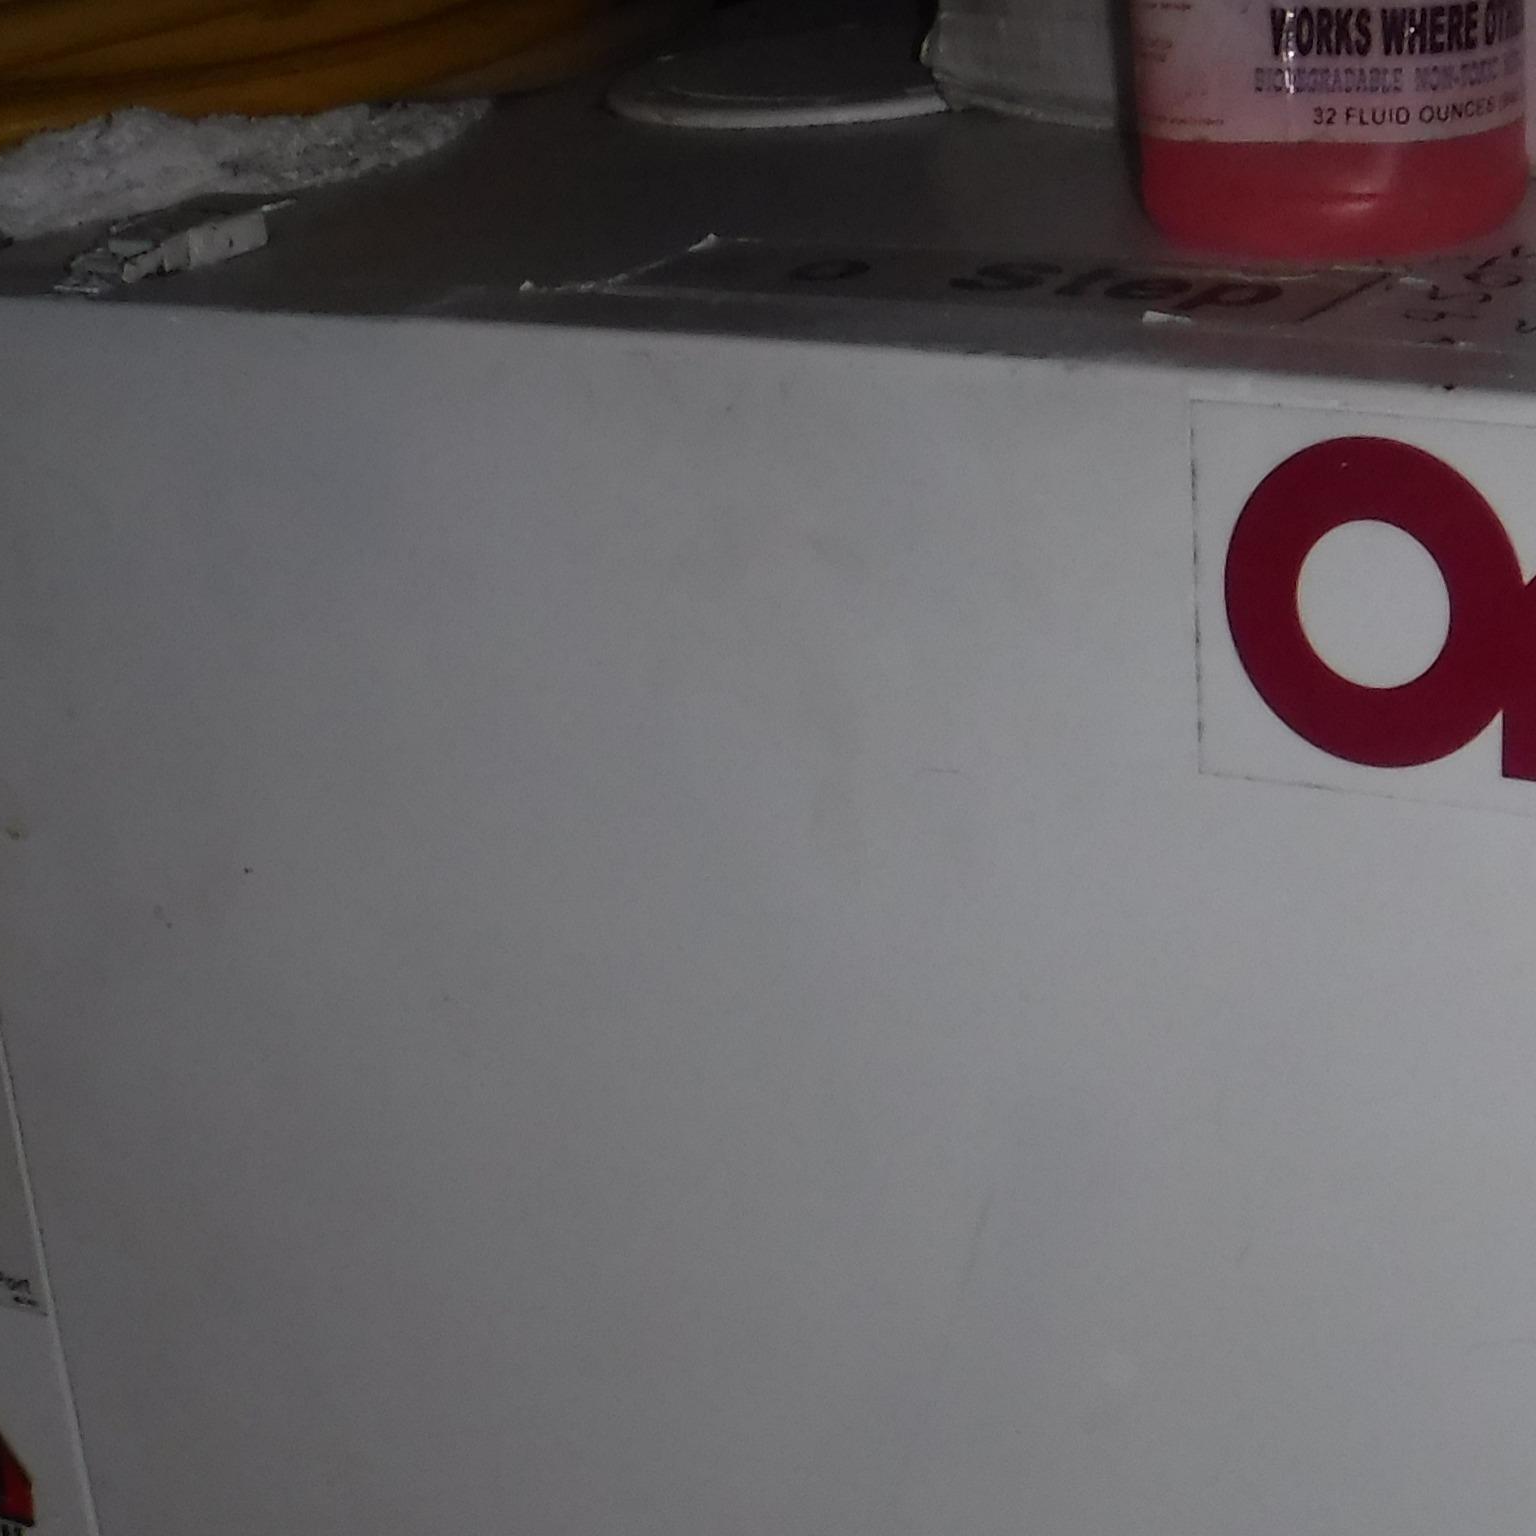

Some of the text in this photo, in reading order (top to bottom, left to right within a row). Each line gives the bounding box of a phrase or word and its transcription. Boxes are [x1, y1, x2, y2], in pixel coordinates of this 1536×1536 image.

[1271, 7, 1372, 56] WORKS
[1382, 2, 1479, 55] WHERE
[1313, 106, 1337, 125] 32
[1345, 105, 1411, 126] FLUID
[1418, 97, 1495, 123] OUNCES
